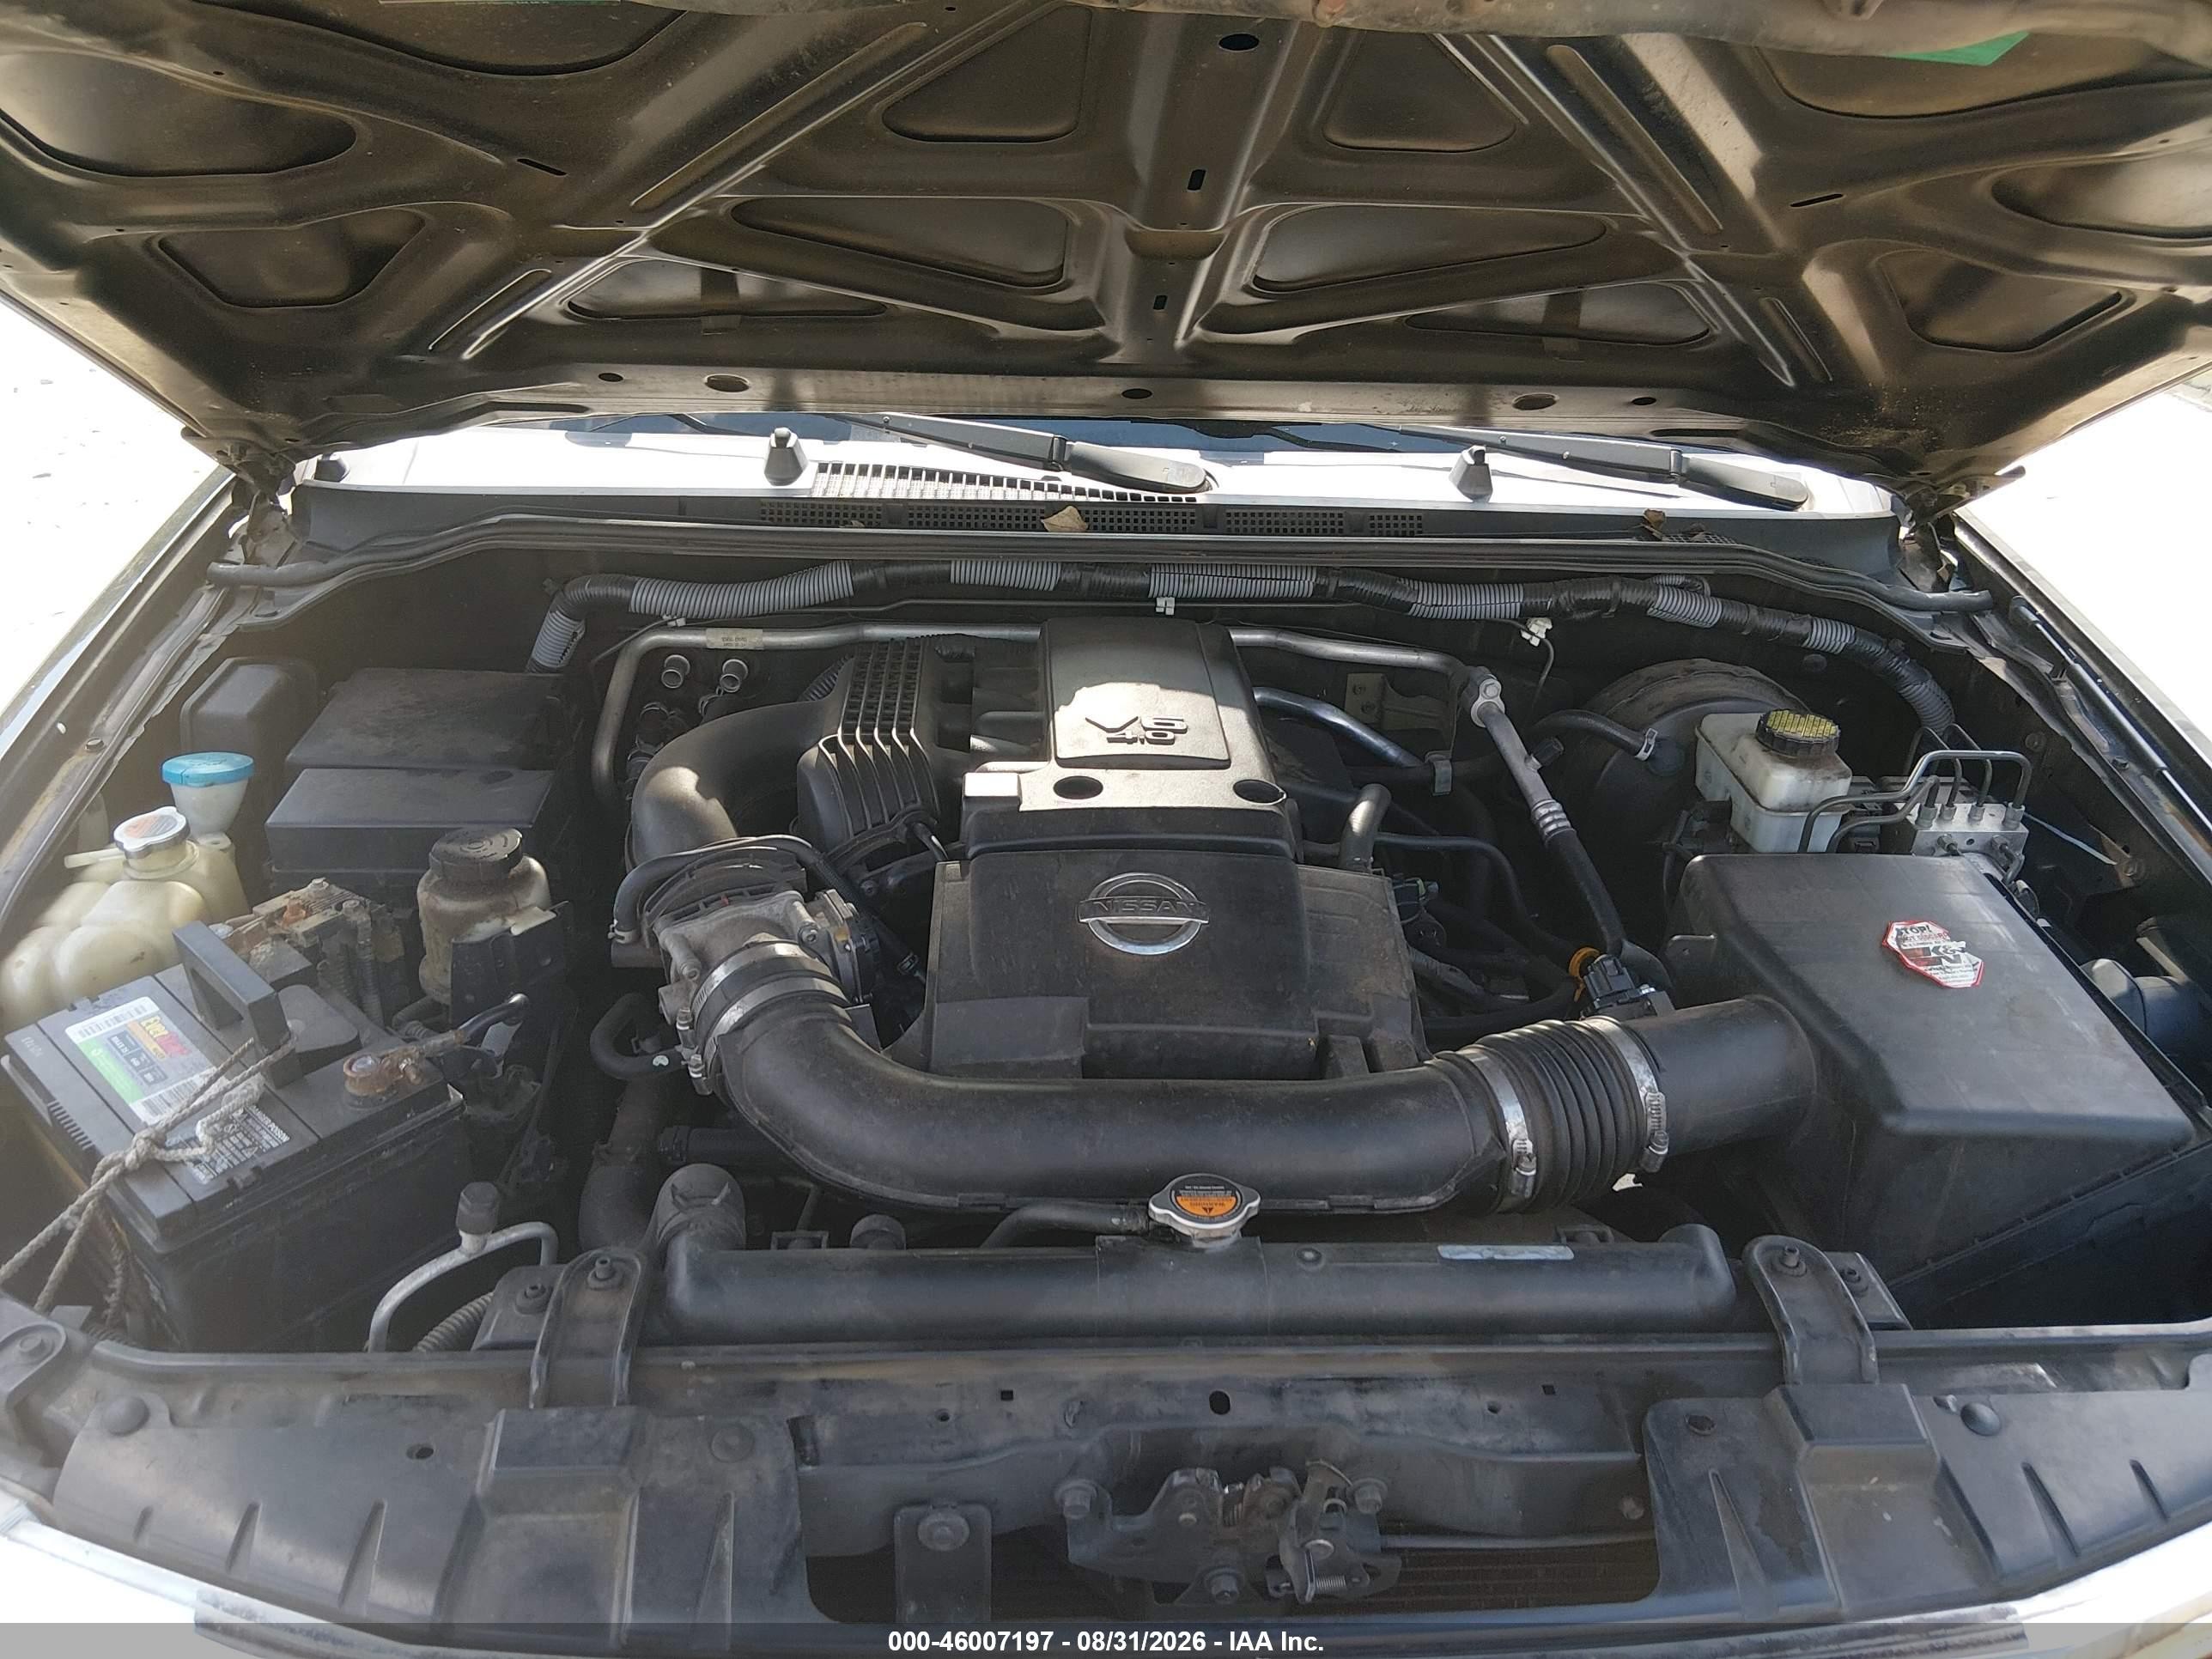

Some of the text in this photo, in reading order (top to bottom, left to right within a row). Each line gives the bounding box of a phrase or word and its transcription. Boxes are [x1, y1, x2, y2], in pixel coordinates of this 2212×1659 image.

[1085, 714, 1188, 734] V6
[1106, 729, 1175, 745] 4.0
[1092, 899, 1196, 913] NISSAN
